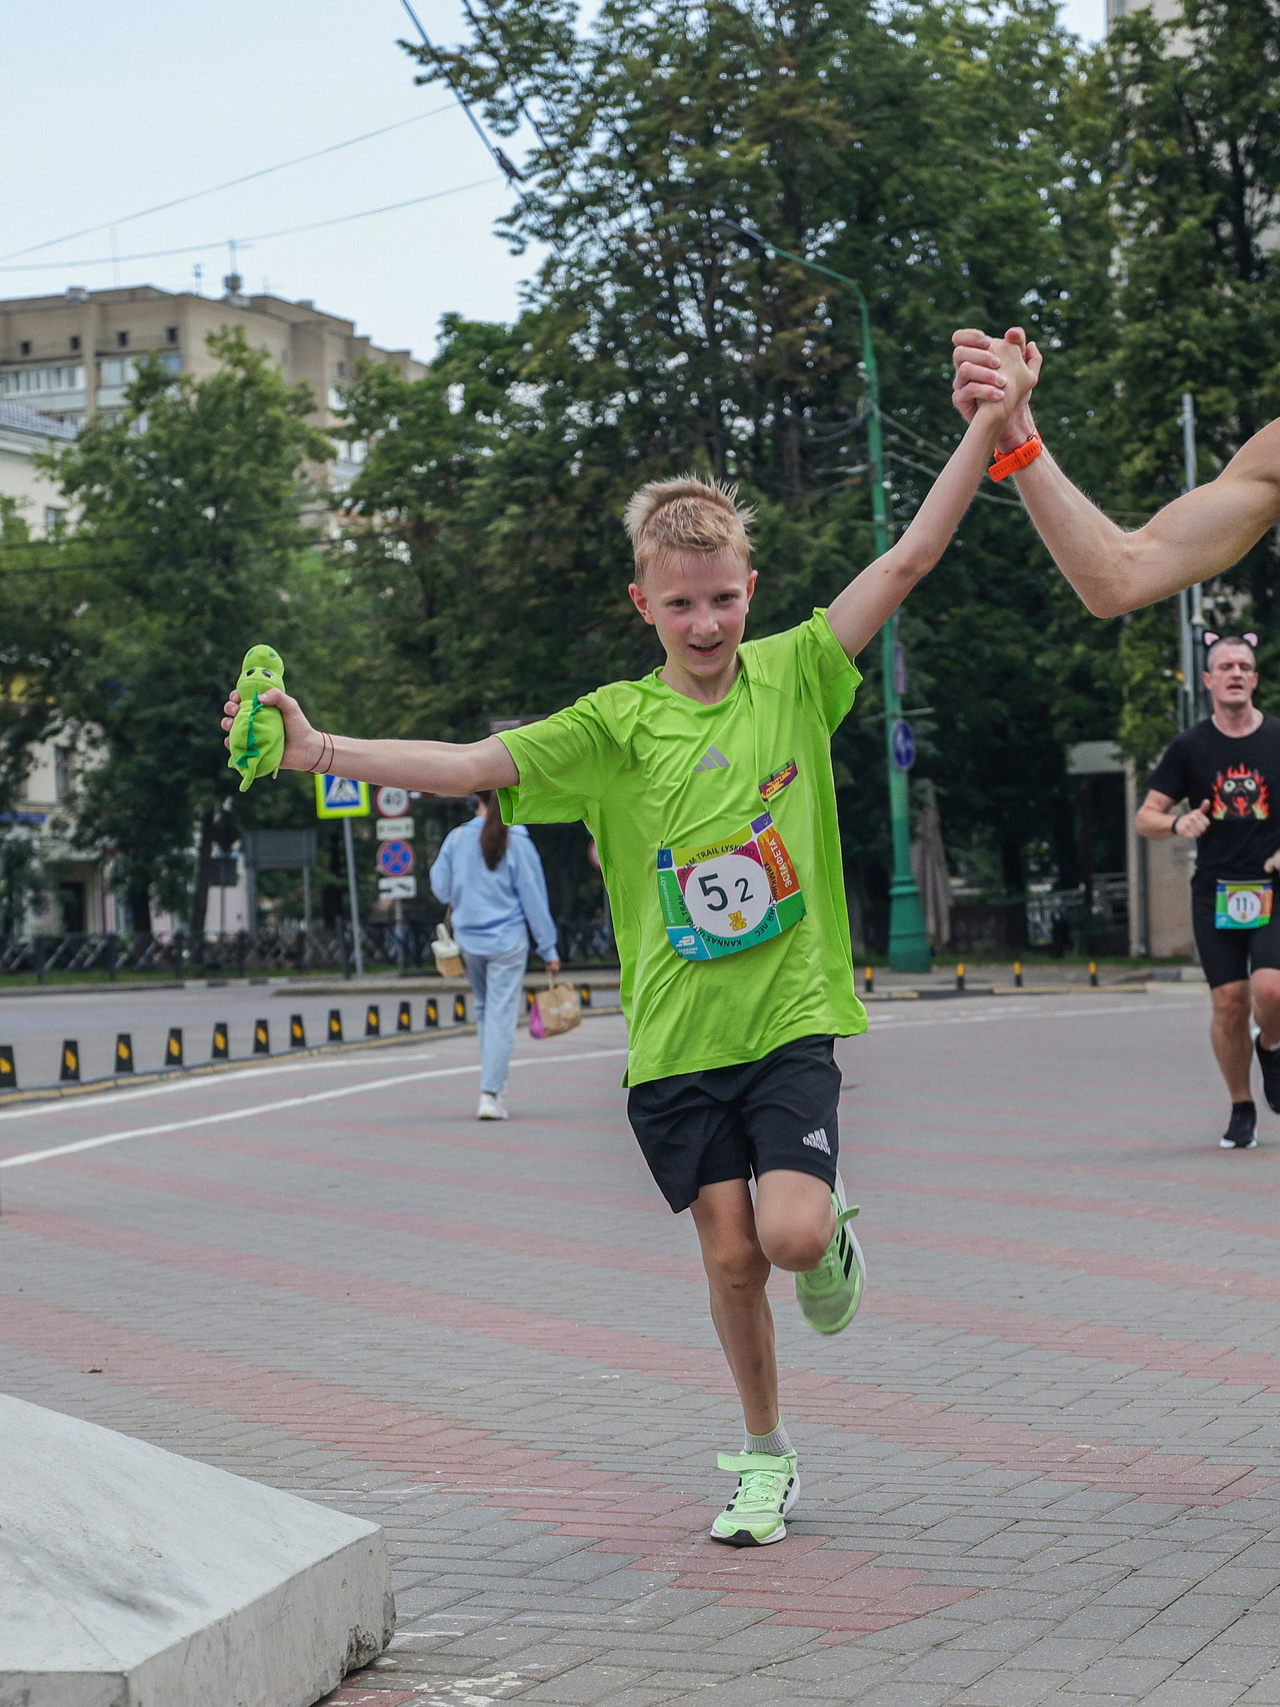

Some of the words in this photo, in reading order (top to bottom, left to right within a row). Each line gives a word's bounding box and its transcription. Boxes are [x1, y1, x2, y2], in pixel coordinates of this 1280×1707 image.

[679, 857, 697, 882] DREAM
[696, 846, 720, 860] TRAIL
[720, 844, 756, 857] LYSKOVO
[768, 837, 793, 888] ЭСТАФЕТА
[677, 894, 688, 917] TRAIL
[763, 861, 779, 922] ХИМКИНСКИЙ
[706, 935, 743, 947] KANNAS
[755, 922, 769, 938] ЛЕС
